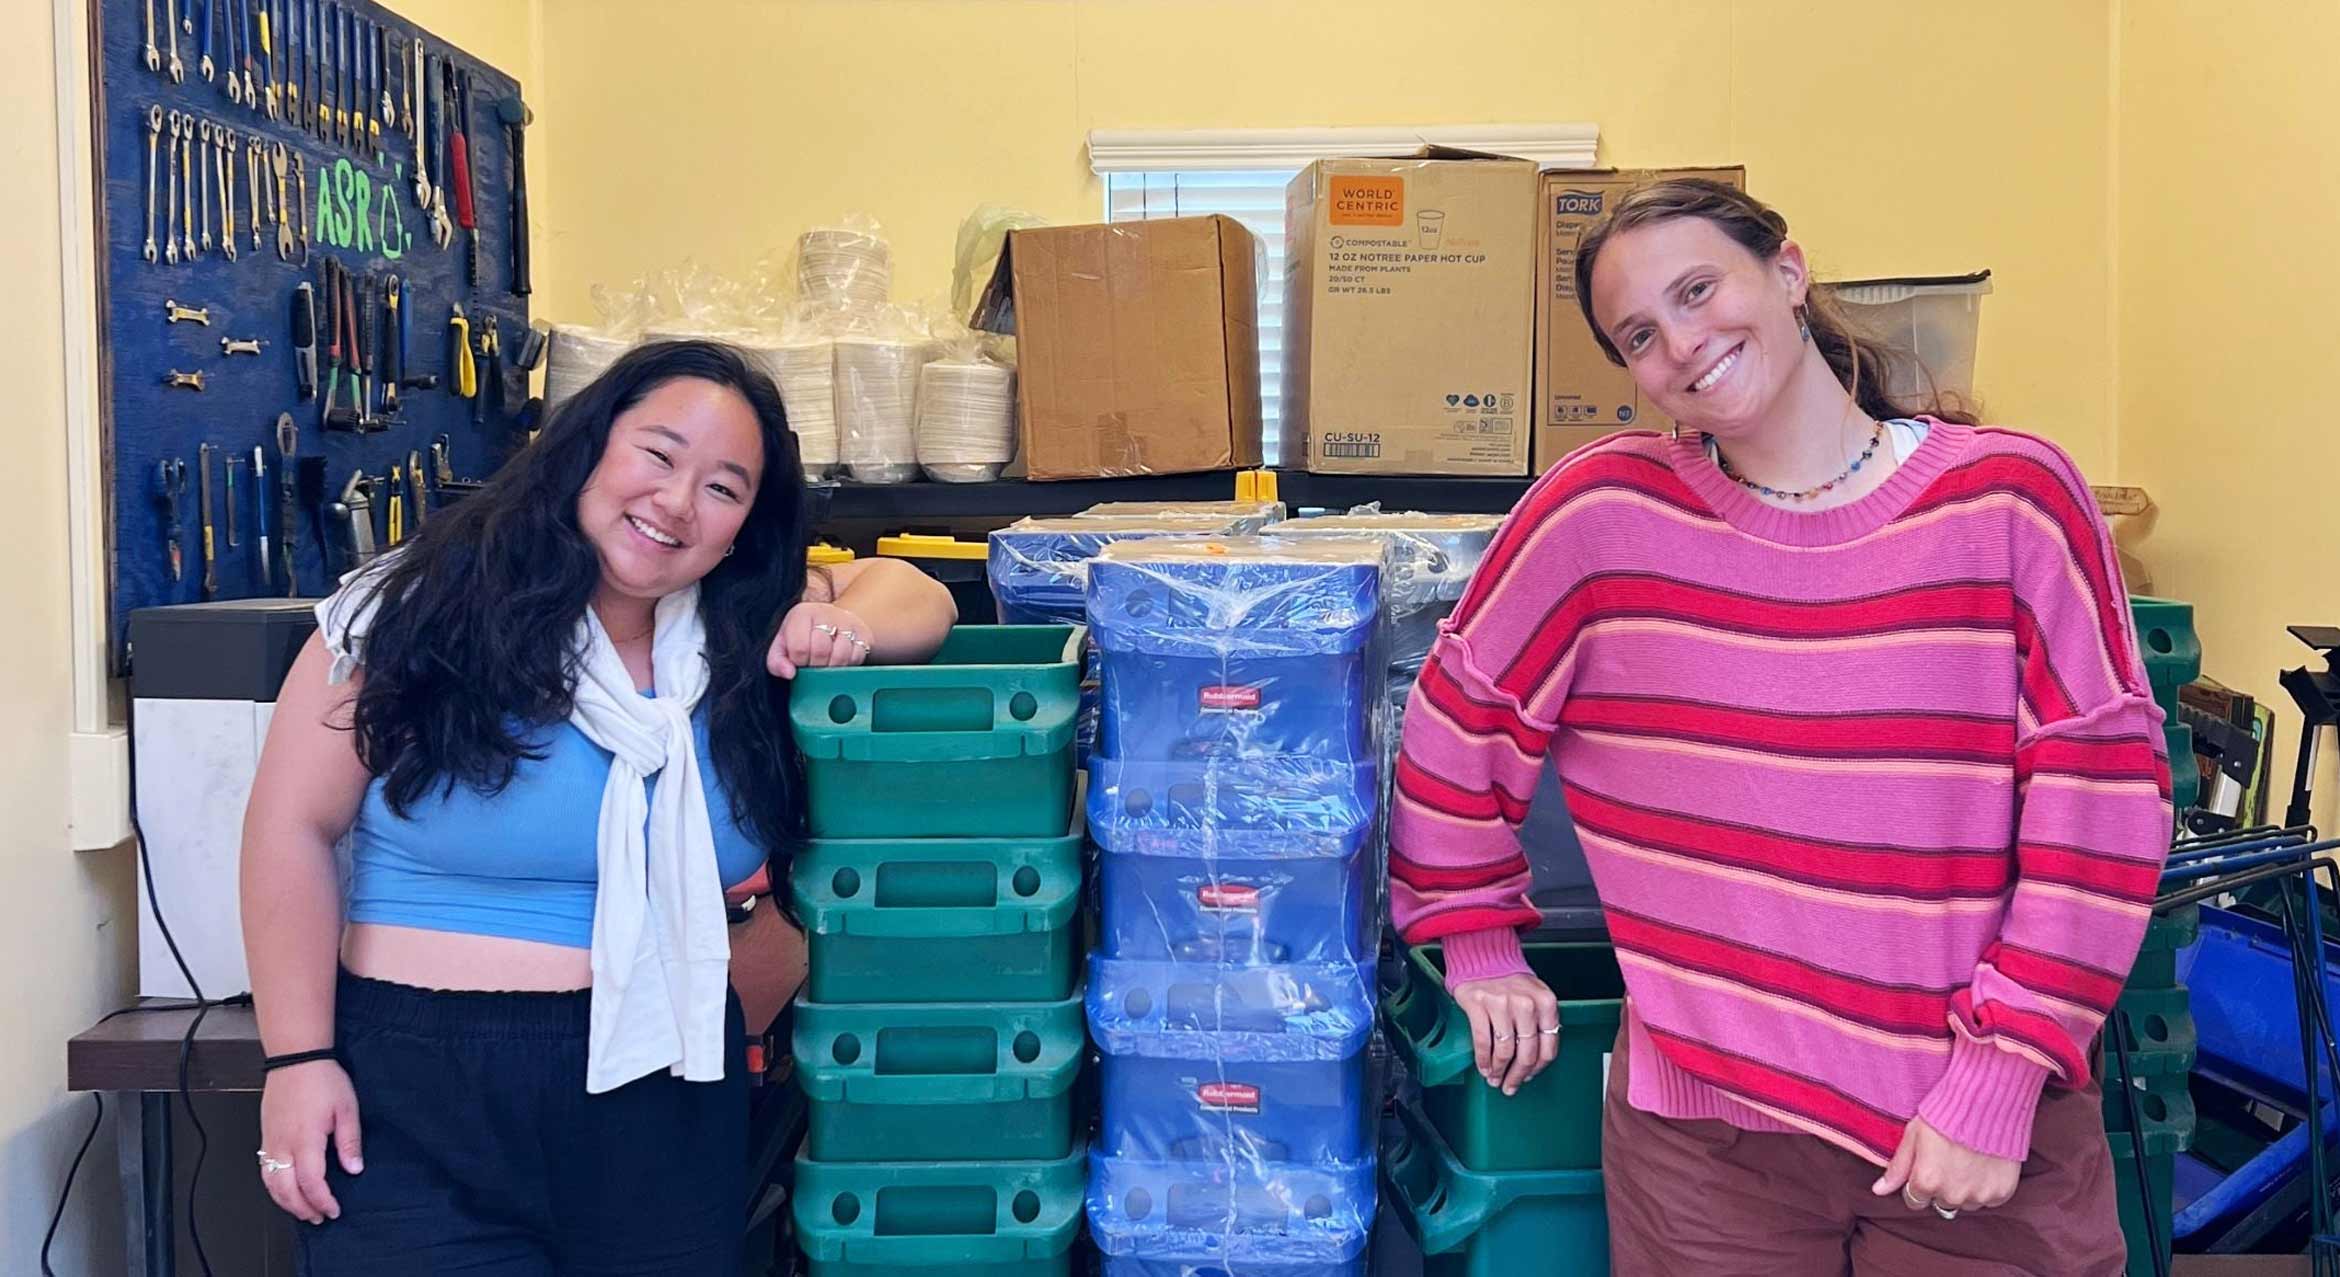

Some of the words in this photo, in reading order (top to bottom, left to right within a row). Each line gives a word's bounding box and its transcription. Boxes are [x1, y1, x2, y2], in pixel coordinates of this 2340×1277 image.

[1343, 188, 1393, 200] WORLD
[316, 158, 373, 253] ASR
[1336, 200, 1399, 212] CENTRIC
[1559, 198, 1601, 212] TORK
[1346, 239, 1408, 248] COMPOSTABLE
[1329, 252, 1339, 261] 12
[1342, 252, 1357, 262] OZ
[1360, 253, 1401, 262] NOTREE
[1404, 254, 1438, 263] PAPER
[1441, 255, 1462, 264] HOT
[1464, 255, 1486, 264] CUP
[1354, 265, 1378, 273] FROM
[1376, 287, 1391, 295] LBS
[1324, 432, 1381, 443] CU-SU-12
